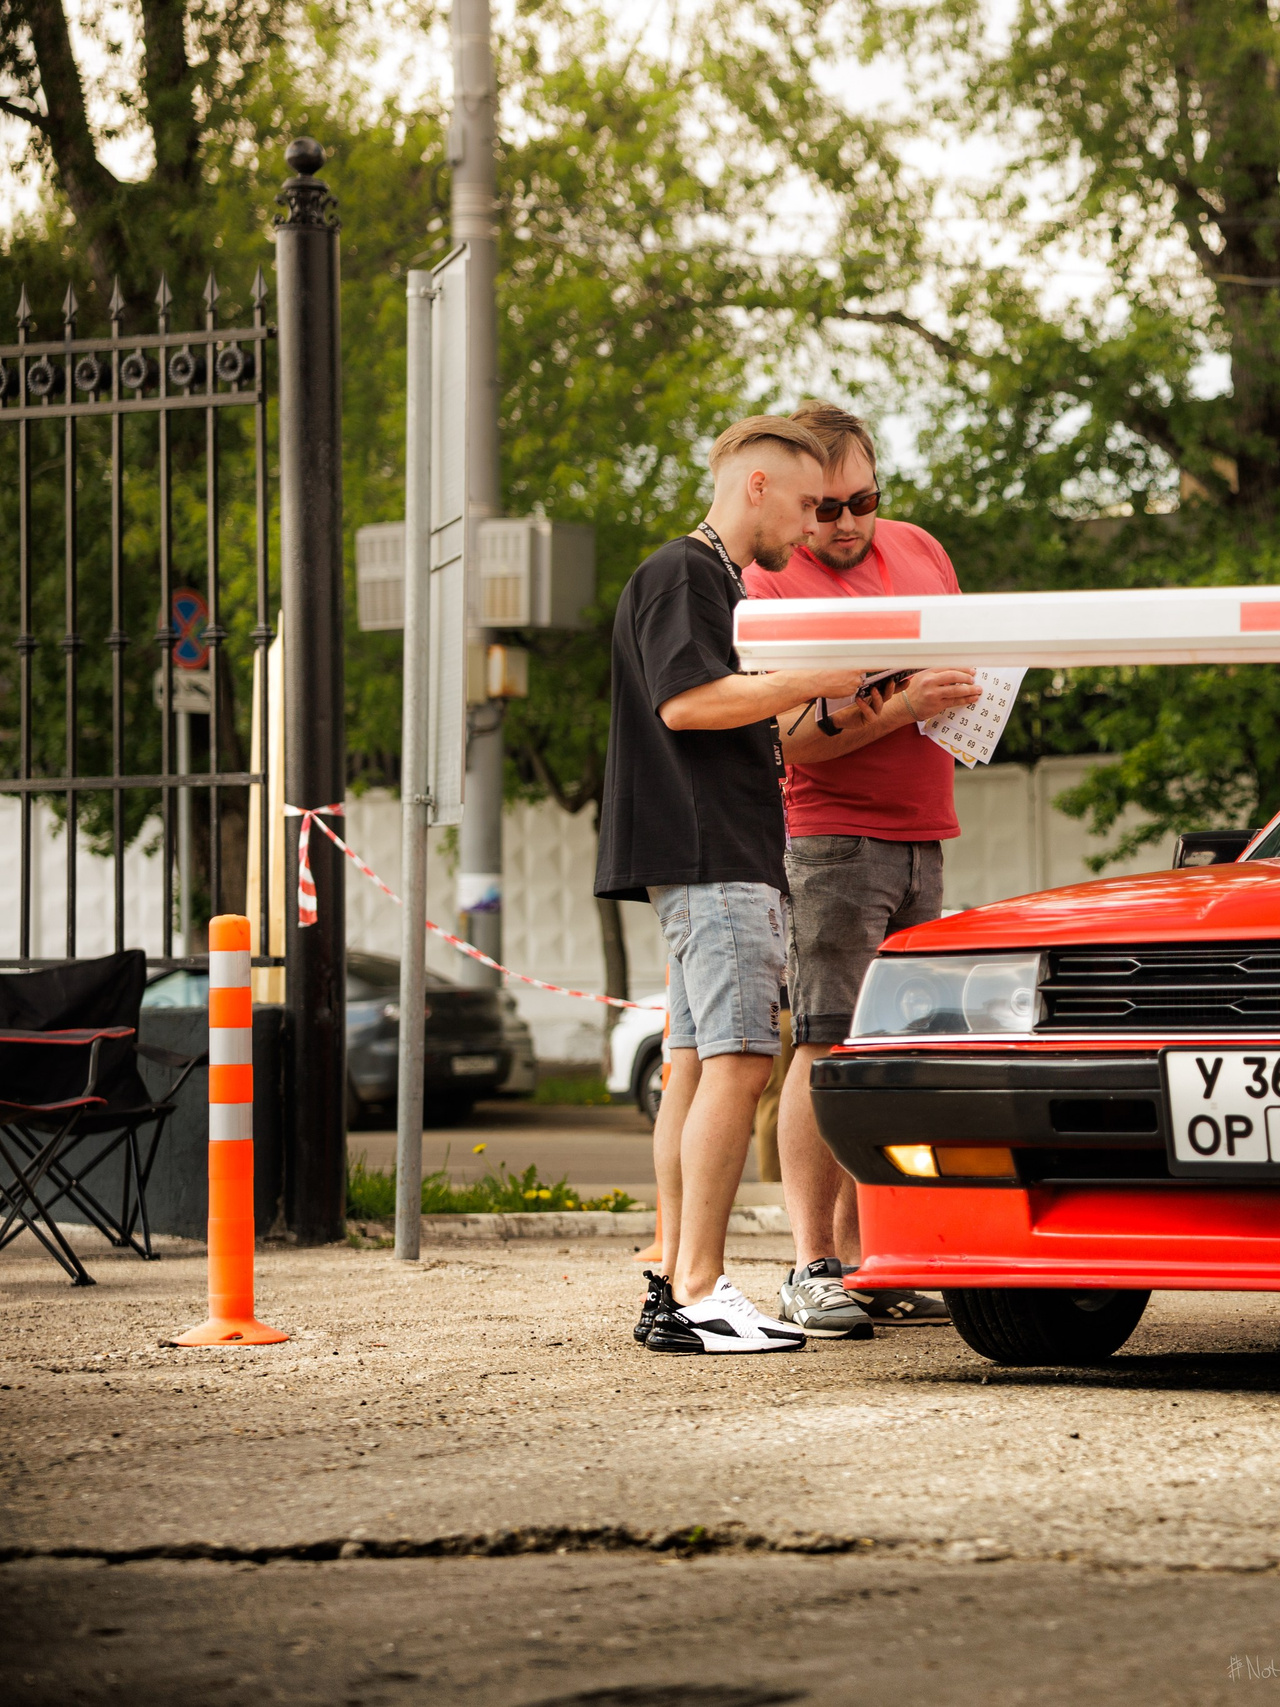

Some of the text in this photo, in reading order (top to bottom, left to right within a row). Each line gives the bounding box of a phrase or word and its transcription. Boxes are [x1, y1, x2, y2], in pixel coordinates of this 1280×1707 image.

[1004, 683, 1011, 691] 20
[987, 693, 1006, 707] 24 25
[967, 703, 1000, 723] 28 29 30
[960, 718, 968, 726] 33
[973, 724, 982, 733] 34
[986, 730, 994, 739] 35
[941, 726, 949, 734] 67
[954, 733, 962, 741] 68
[967, 740, 975, 748] 69
[980, 747, 988, 755] 70
